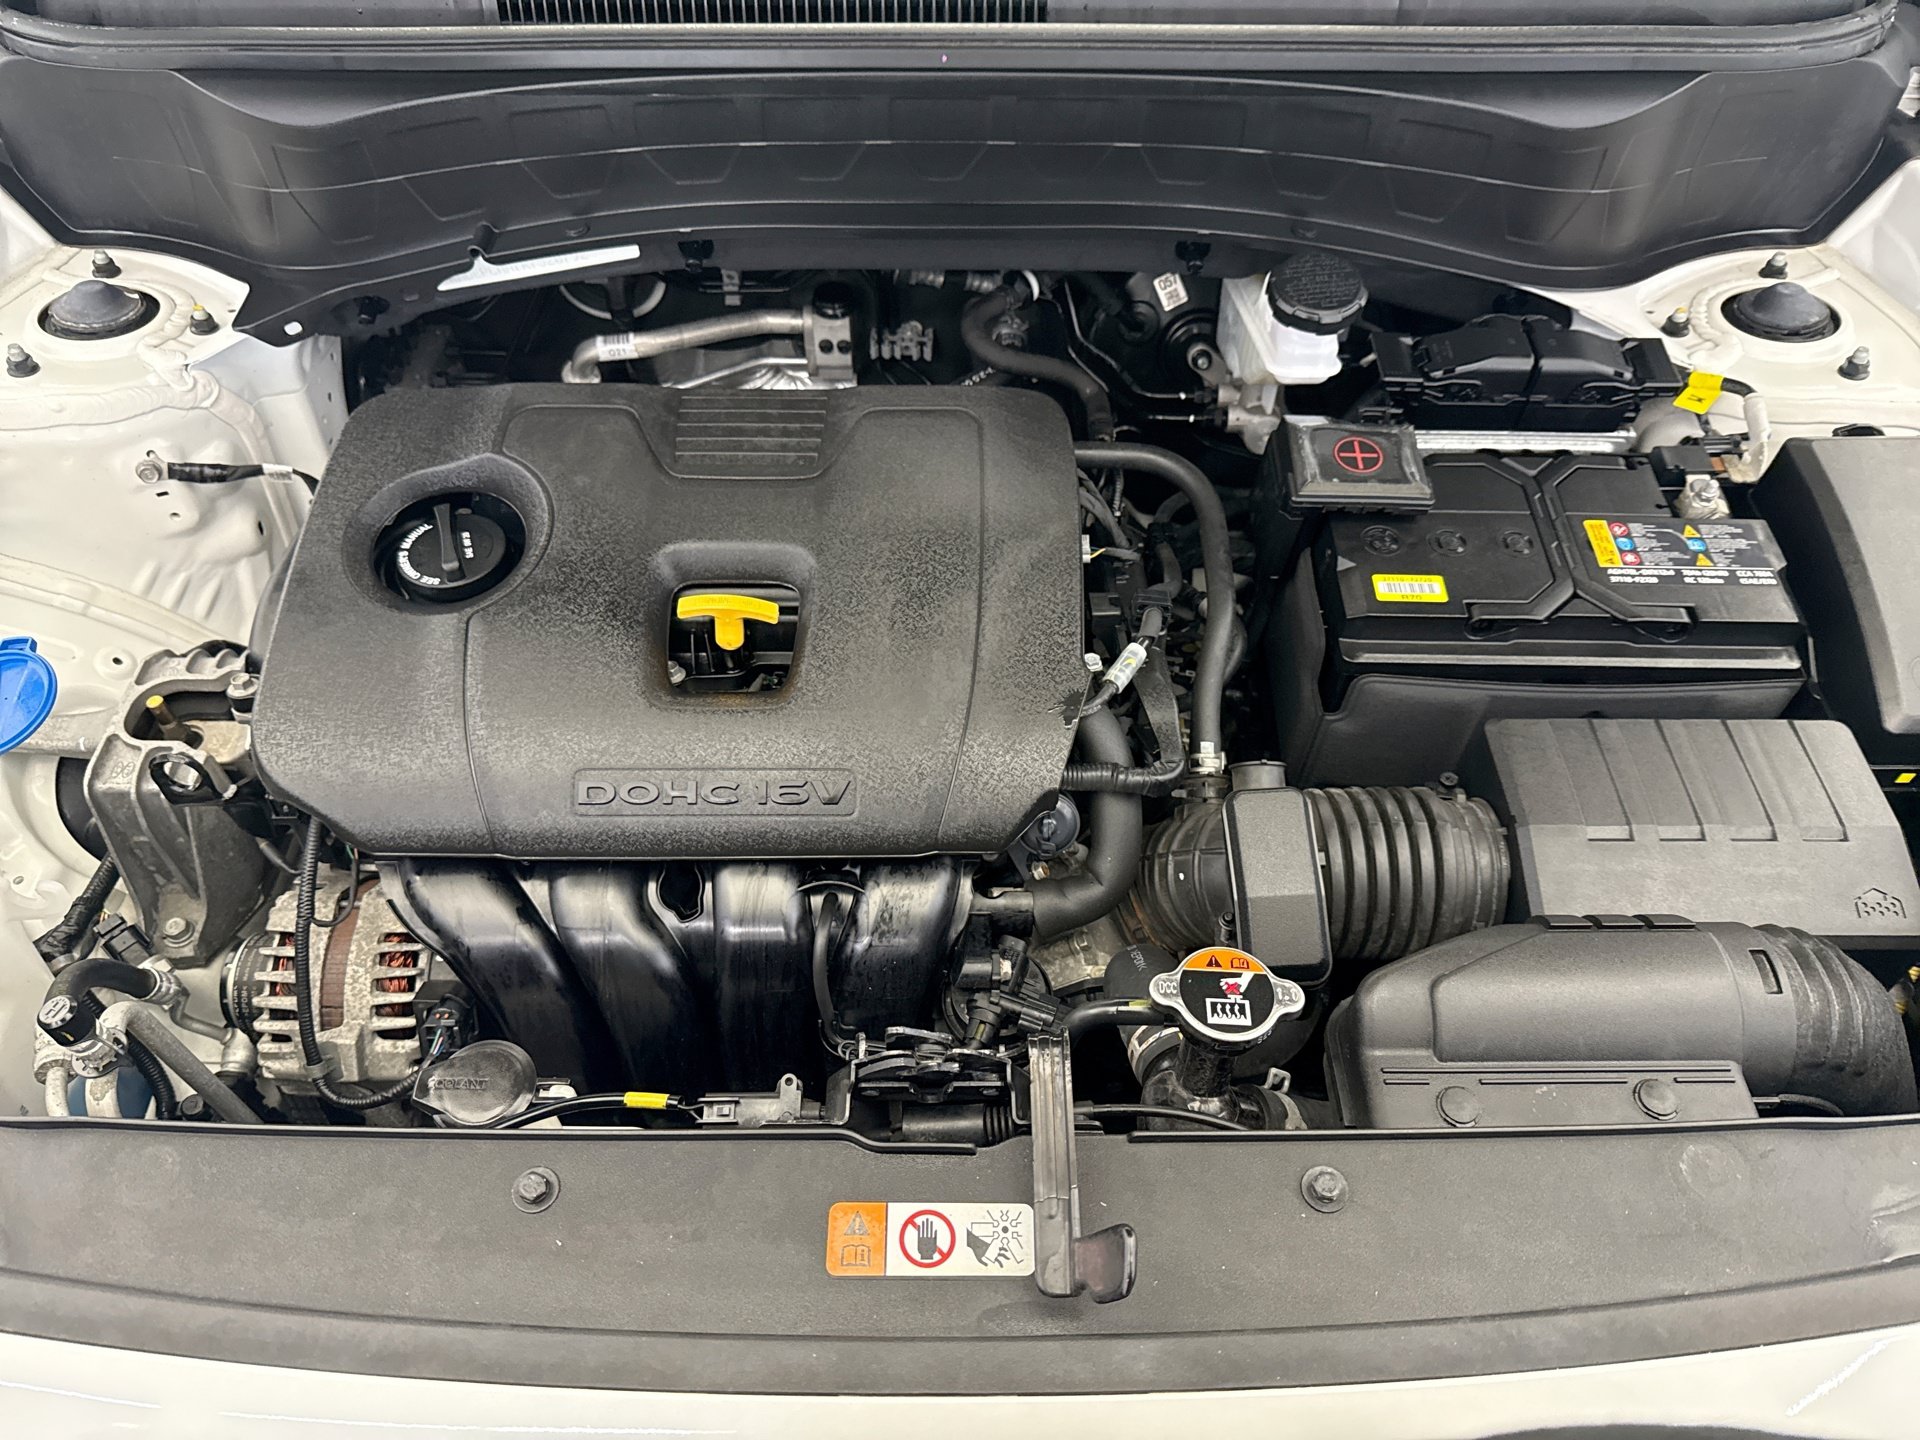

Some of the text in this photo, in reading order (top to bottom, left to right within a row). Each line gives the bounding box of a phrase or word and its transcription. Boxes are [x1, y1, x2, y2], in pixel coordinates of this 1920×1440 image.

[400, 523, 434, 550] MANUAL
[419, 575, 441, 585] SEE
[1735, 570, 1754, 578] CCA
[577, 780, 851, 806] DOHC 16V
[1158, 980, 1178, 994] DCC
